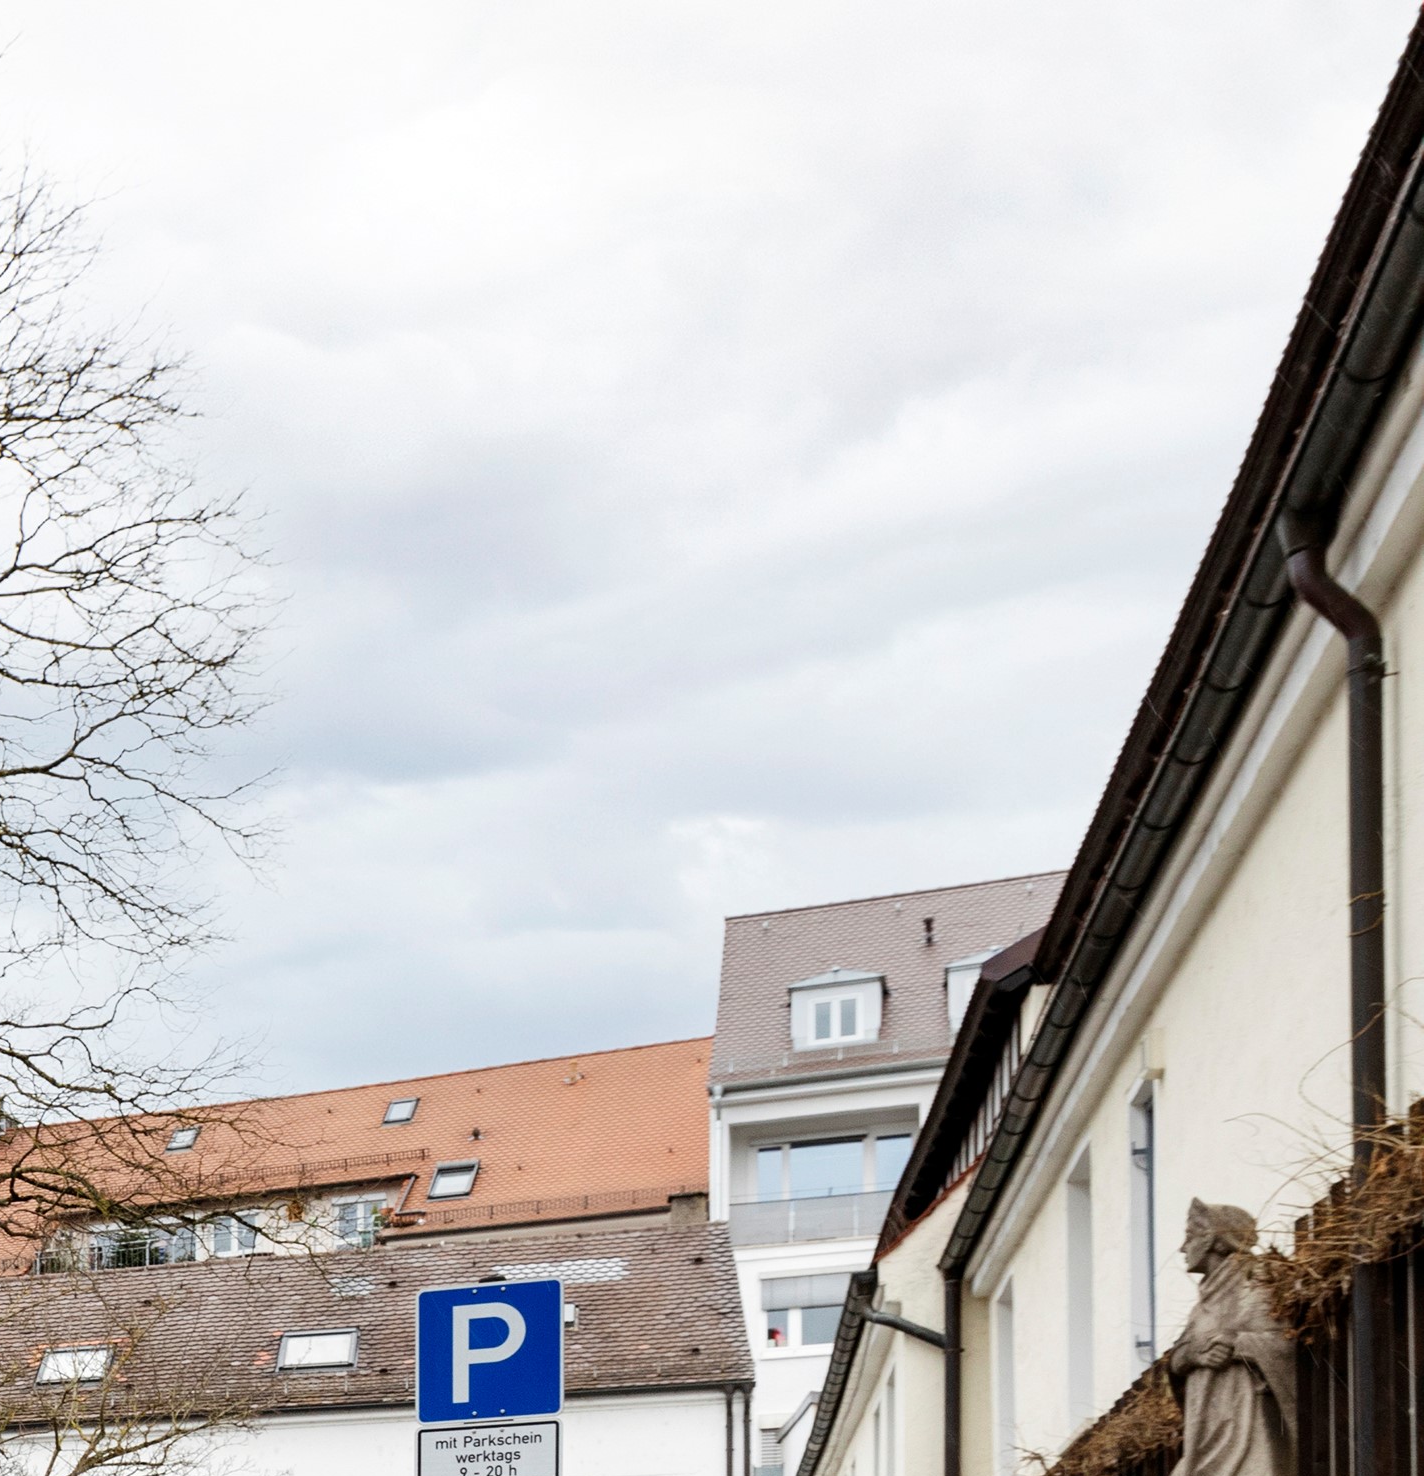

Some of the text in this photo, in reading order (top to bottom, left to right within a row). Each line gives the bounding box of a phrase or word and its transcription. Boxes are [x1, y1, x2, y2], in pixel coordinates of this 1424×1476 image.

[452, 1302, 527, 1404] P
[435, 1432, 543, 1450] mit Parkschein
[455, 1449, 521, 1464] werktags
[509, 1464, 517, 1476] h
